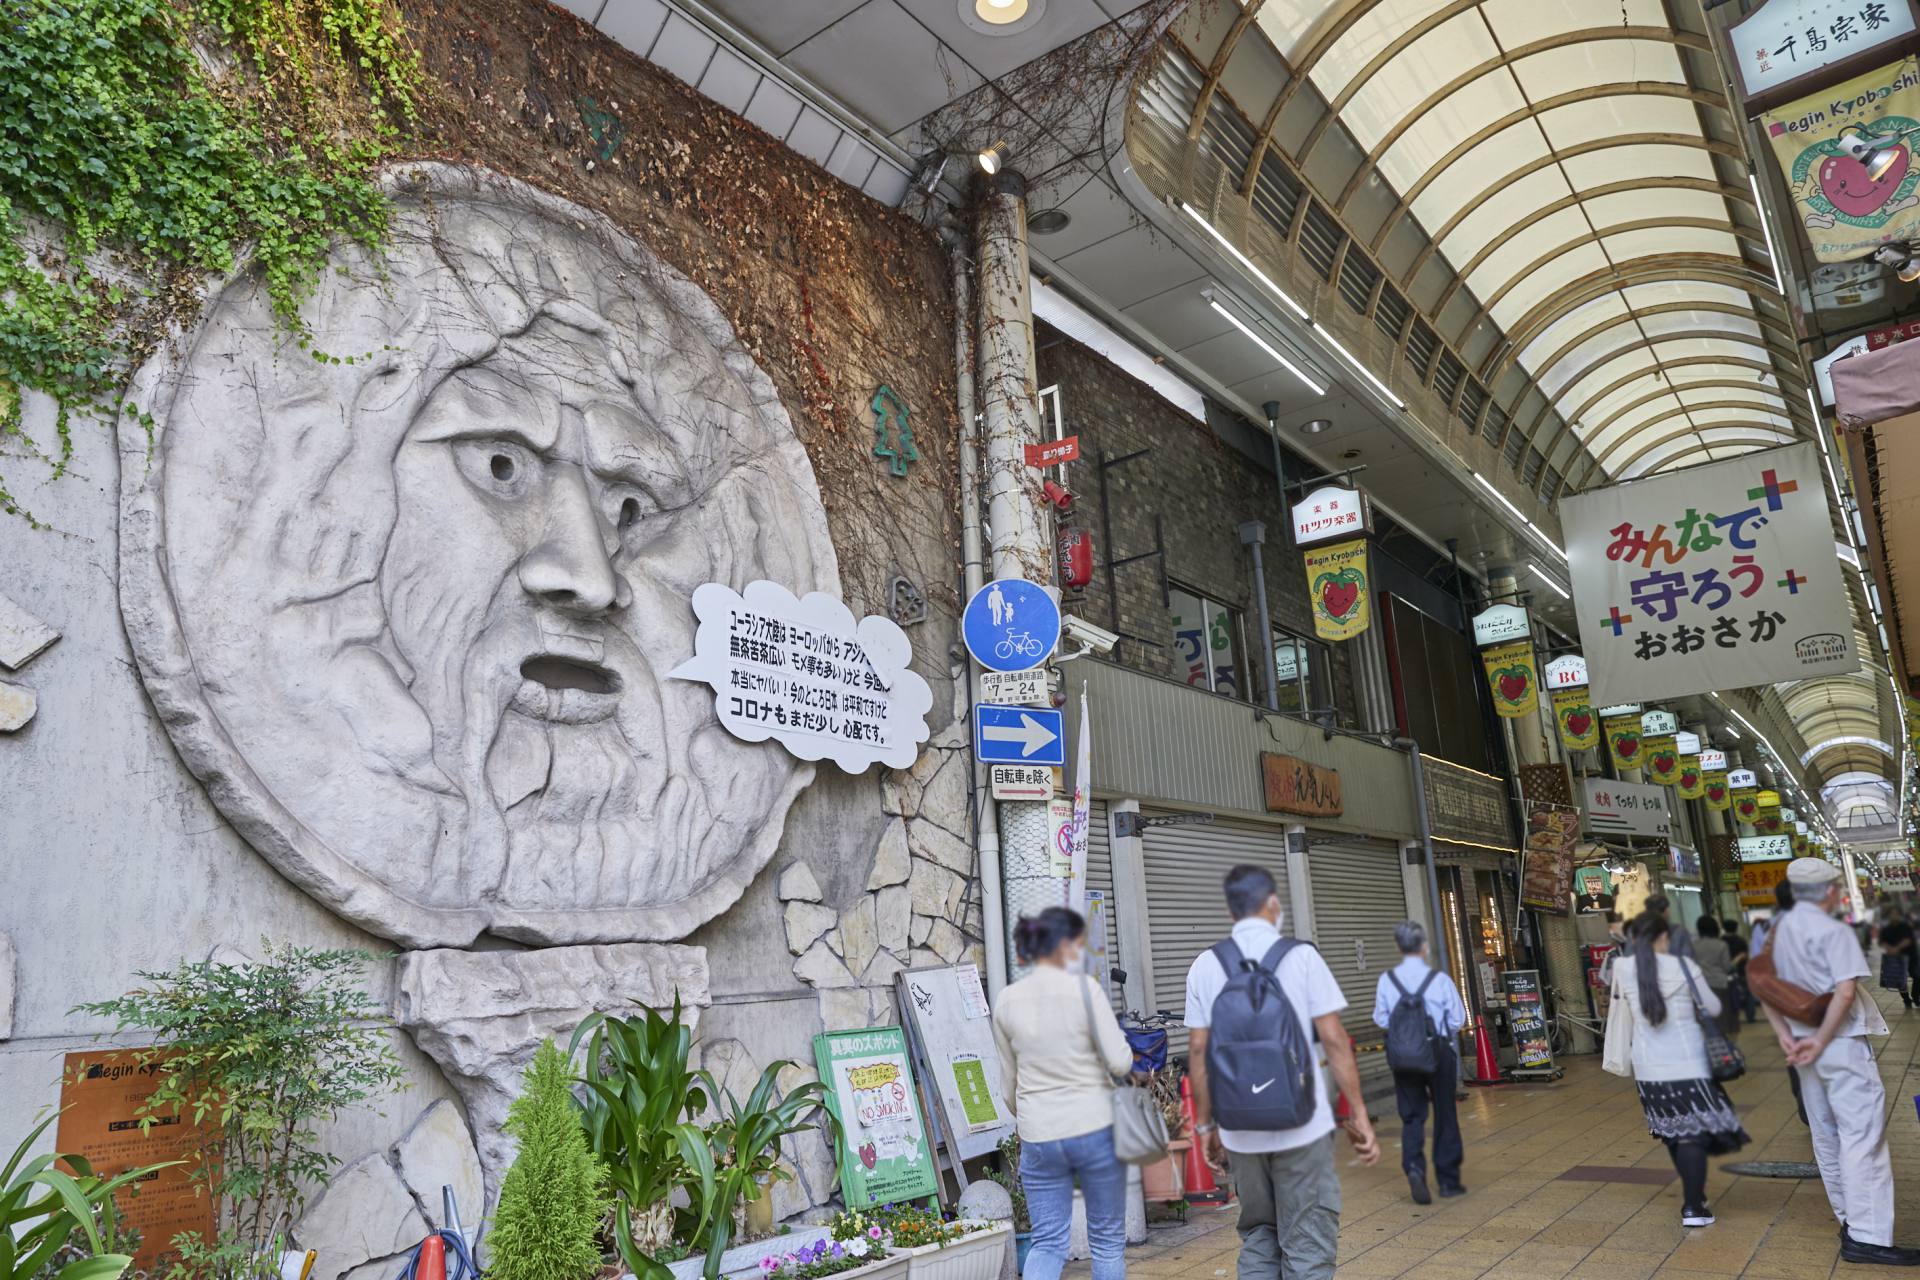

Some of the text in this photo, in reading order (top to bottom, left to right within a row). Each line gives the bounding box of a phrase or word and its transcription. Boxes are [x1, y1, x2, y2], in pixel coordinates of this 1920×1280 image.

[1773, 3, 1890, 62] 千鳥宗家
[1606, 507, 1768, 568] みんなで
[1630, 555, 1764, 622] 守ろう
[730, 610, 786, 643] ユーラシア大陸は
[790, 626, 839, 658] ヨーロッパから
[730, 634, 786, 666] 無茶苦茶広い
[791, 652, 841, 680] モメ事も多い
[1634, 610, 1787, 661] おおさか
[1559, 670, 1581, 683] BC
[730, 696, 885, 744] コロナも まだ少し 心配です。
[994, 769, 1051, 784] 自転車を除く
[829, 1034, 899, 1057] 真実のスポット
[1512, 1018, 1541, 1034] Darts
[862, 1101, 908, 1119] NO SMOKING
